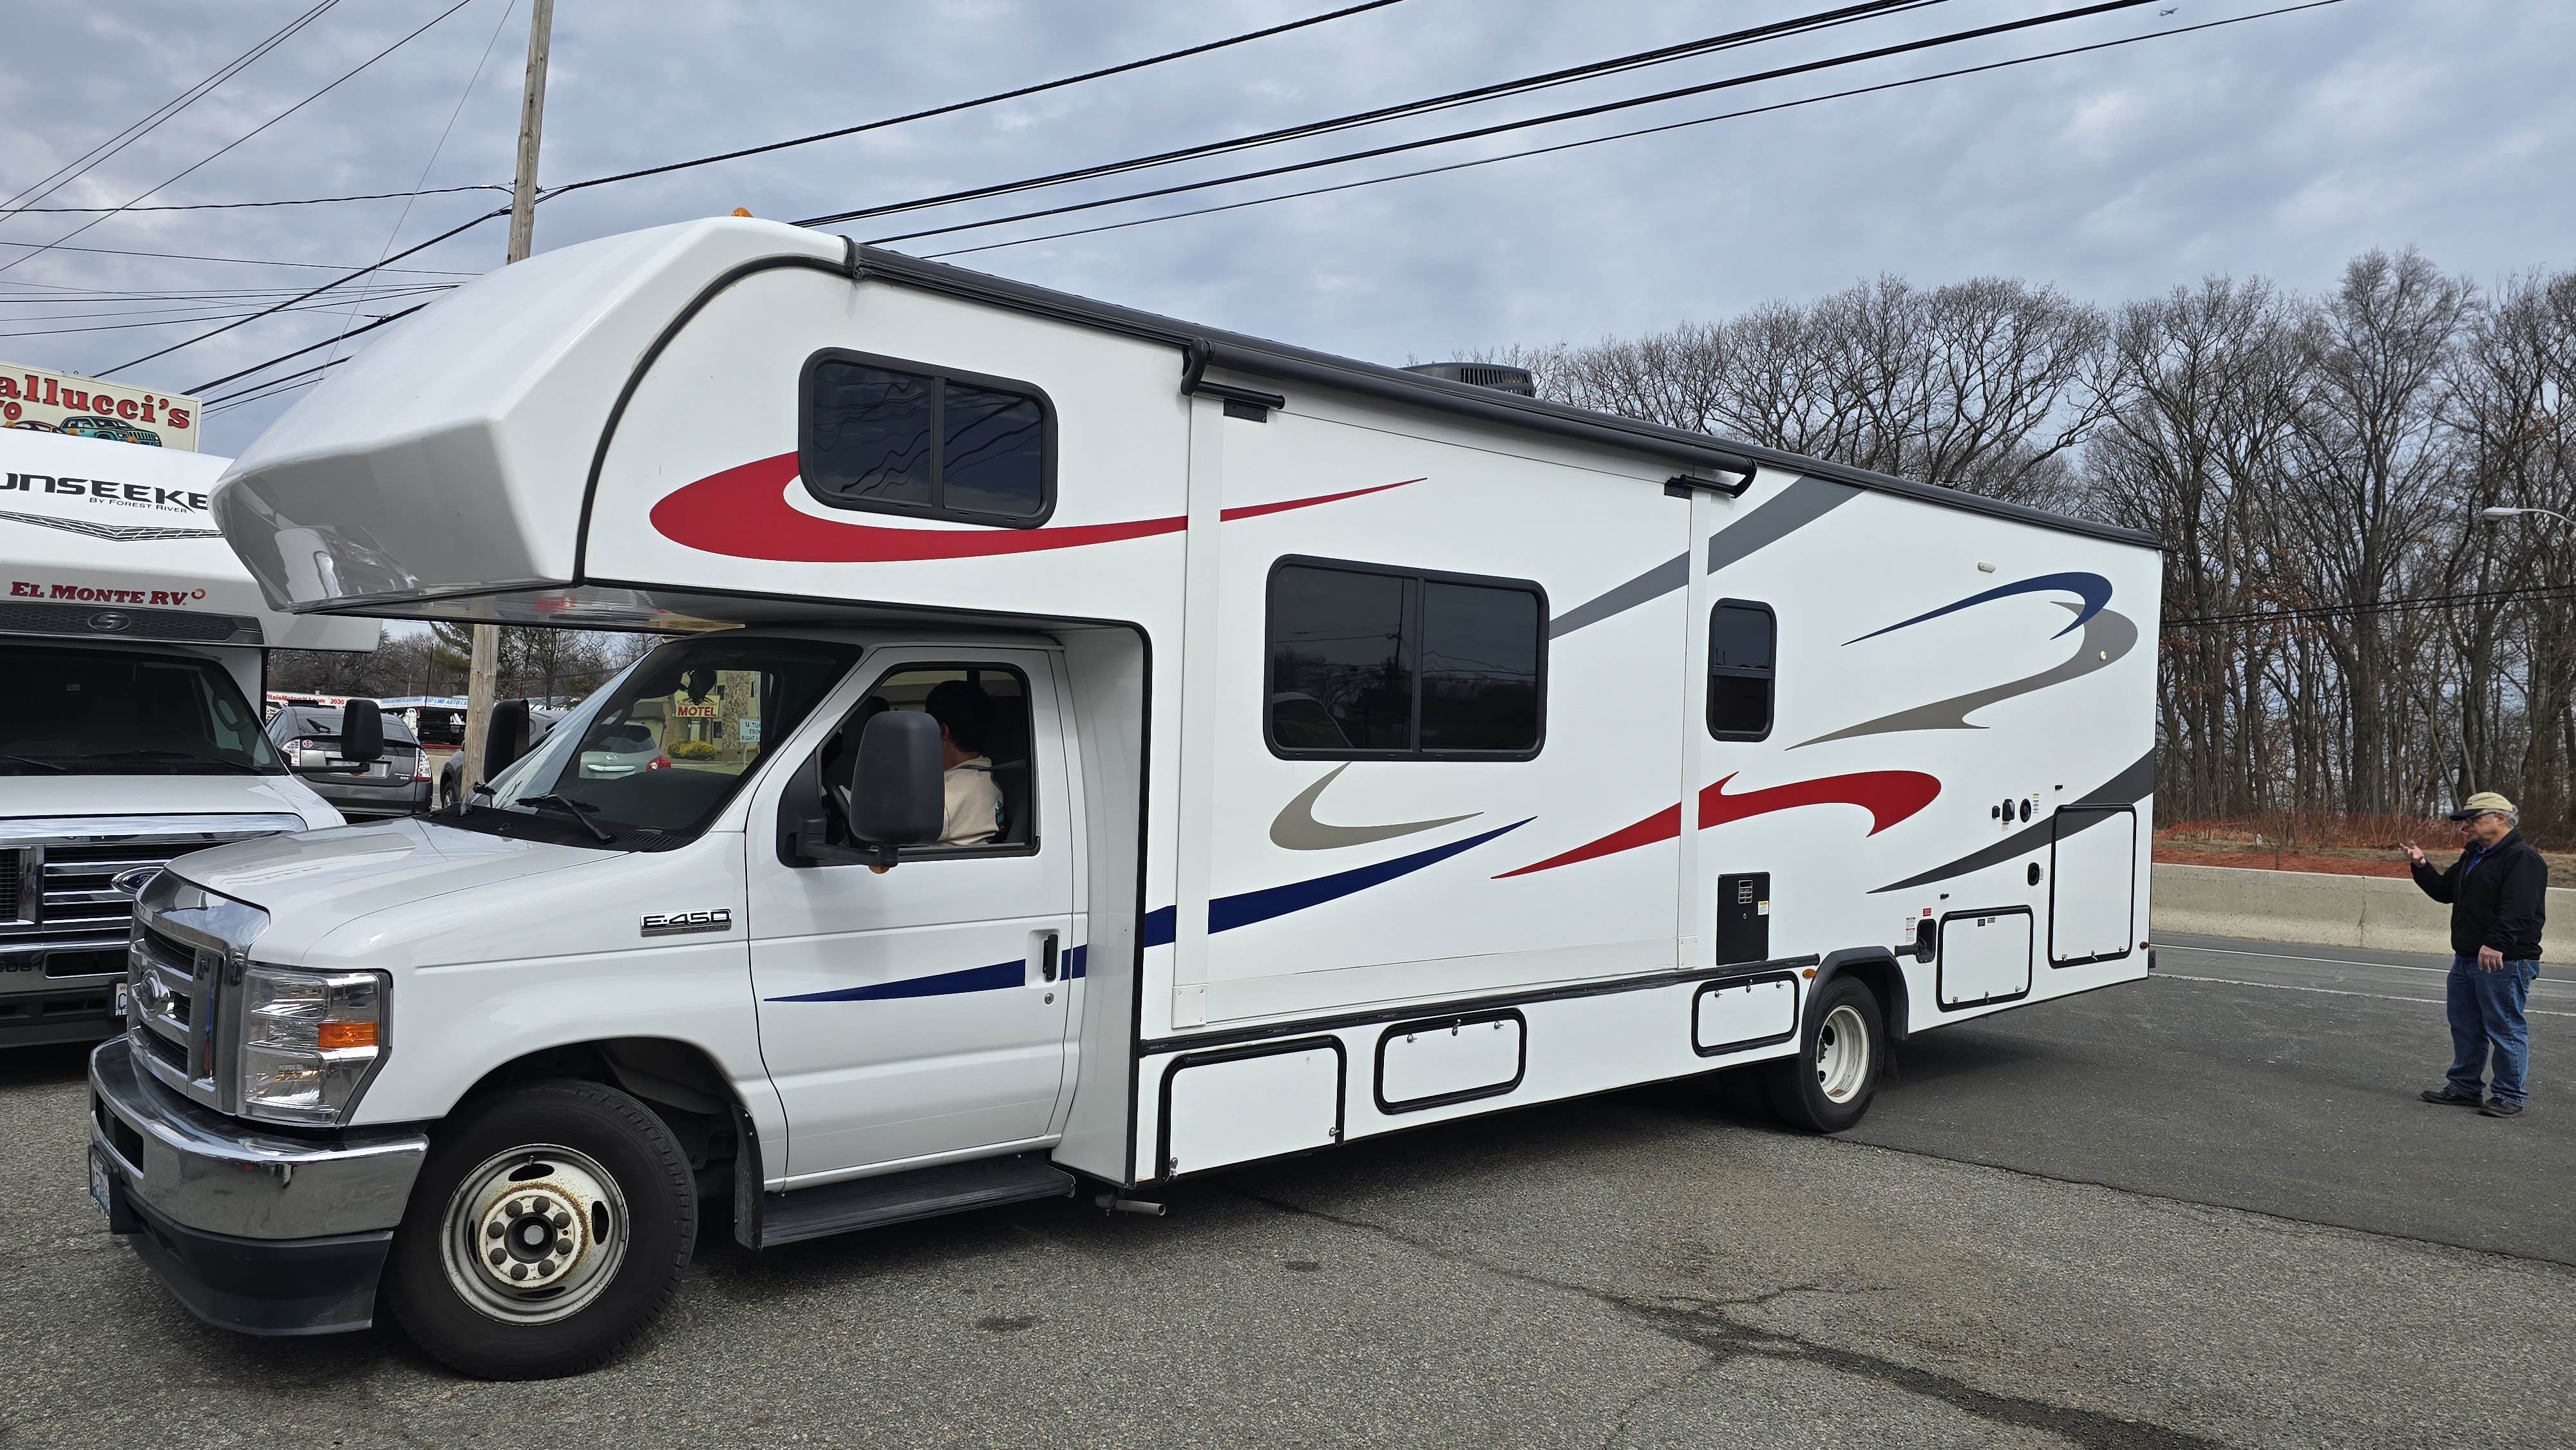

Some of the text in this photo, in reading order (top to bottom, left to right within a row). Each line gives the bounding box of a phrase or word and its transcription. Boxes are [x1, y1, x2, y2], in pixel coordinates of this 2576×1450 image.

[109, 499, 151, 510] FOREST
[156, 505, 187, 514] RIVER
[10, 581, 44, 598] EL
[50, 584, 146, 603] MONTE
[677, 706, 716, 717] MOTEL
